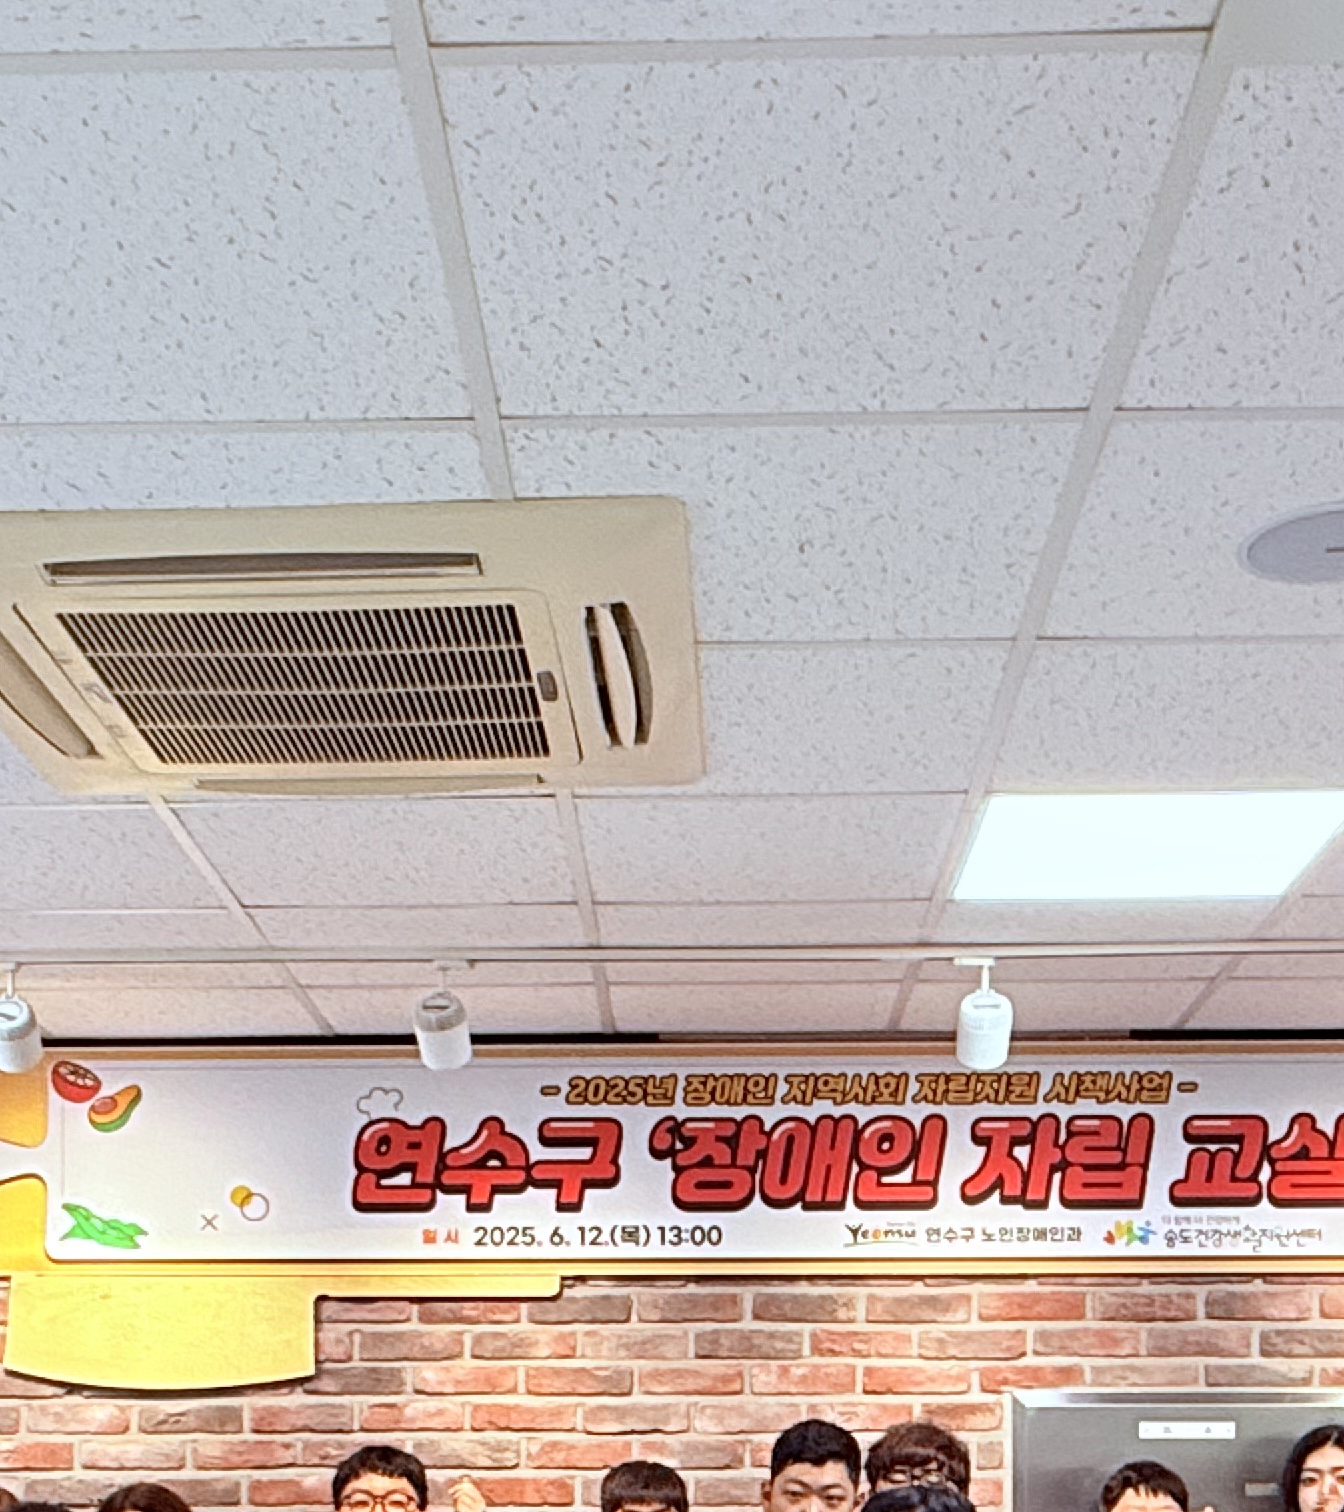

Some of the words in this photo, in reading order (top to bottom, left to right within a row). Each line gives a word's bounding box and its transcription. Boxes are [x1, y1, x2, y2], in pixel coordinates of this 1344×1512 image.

[565, 1072, 676, 1107] 2025년
[683, 1072, 777, 1106] 장애인
[782, 1072, 908, 1106] 지역사회
[913, 1071, 1041, 1105] 자립지원
[1045, 1071, 1172, 1105] 시책사업
[352, 1115, 623, 1212] 연수구
[960, 1113, 1156, 1210] 자립
[473, 1225, 544, 1248] 2025.
[549, 1225, 572, 1248] 6.
[657, 1225, 723, 1248] 13:00
[924, 1226, 976, 1244] 연수구
[980, 1226, 1083, 1244] 노인장애인과
